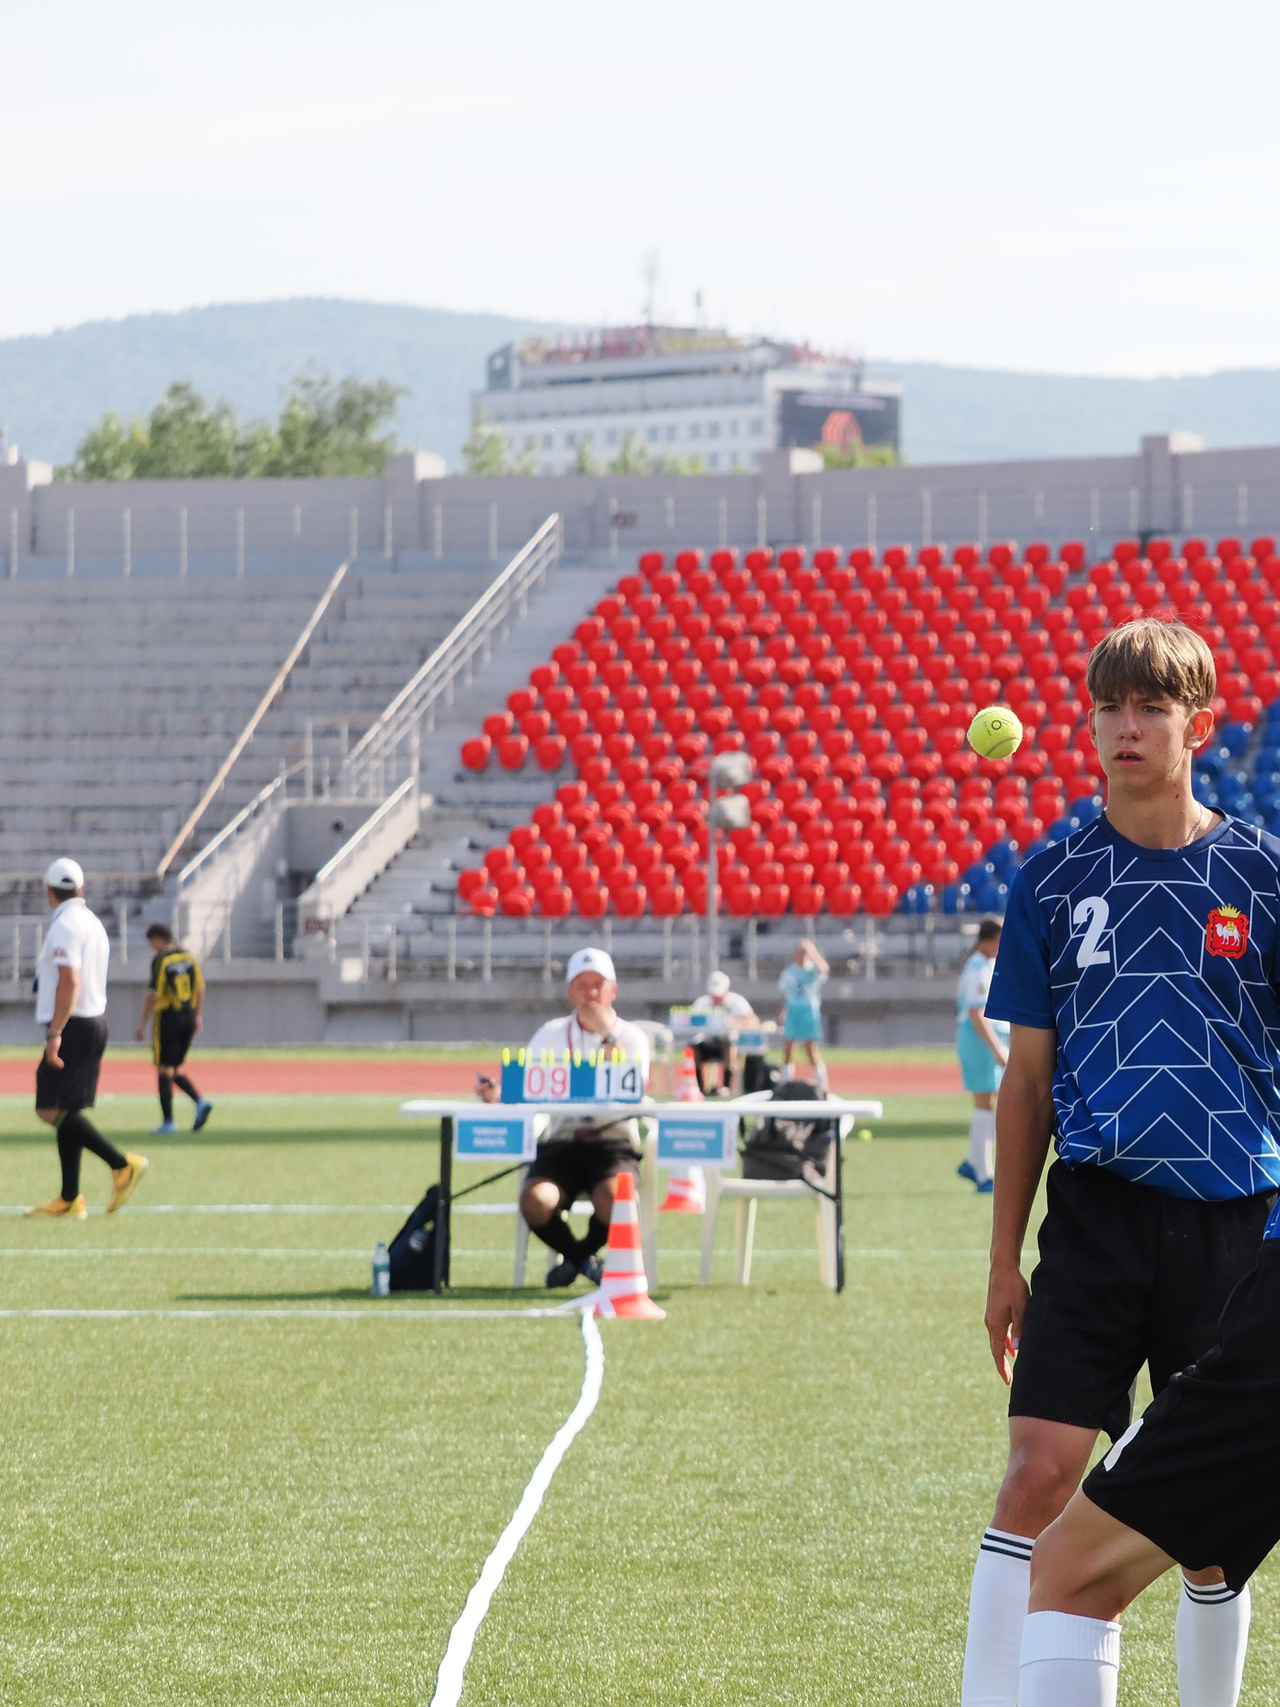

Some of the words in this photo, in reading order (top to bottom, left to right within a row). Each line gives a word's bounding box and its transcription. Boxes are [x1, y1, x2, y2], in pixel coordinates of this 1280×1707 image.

[1073, 896, 1110, 968] 2
[527, 1065, 567, 1097] 09
[605, 1066, 637, 1094] 14
